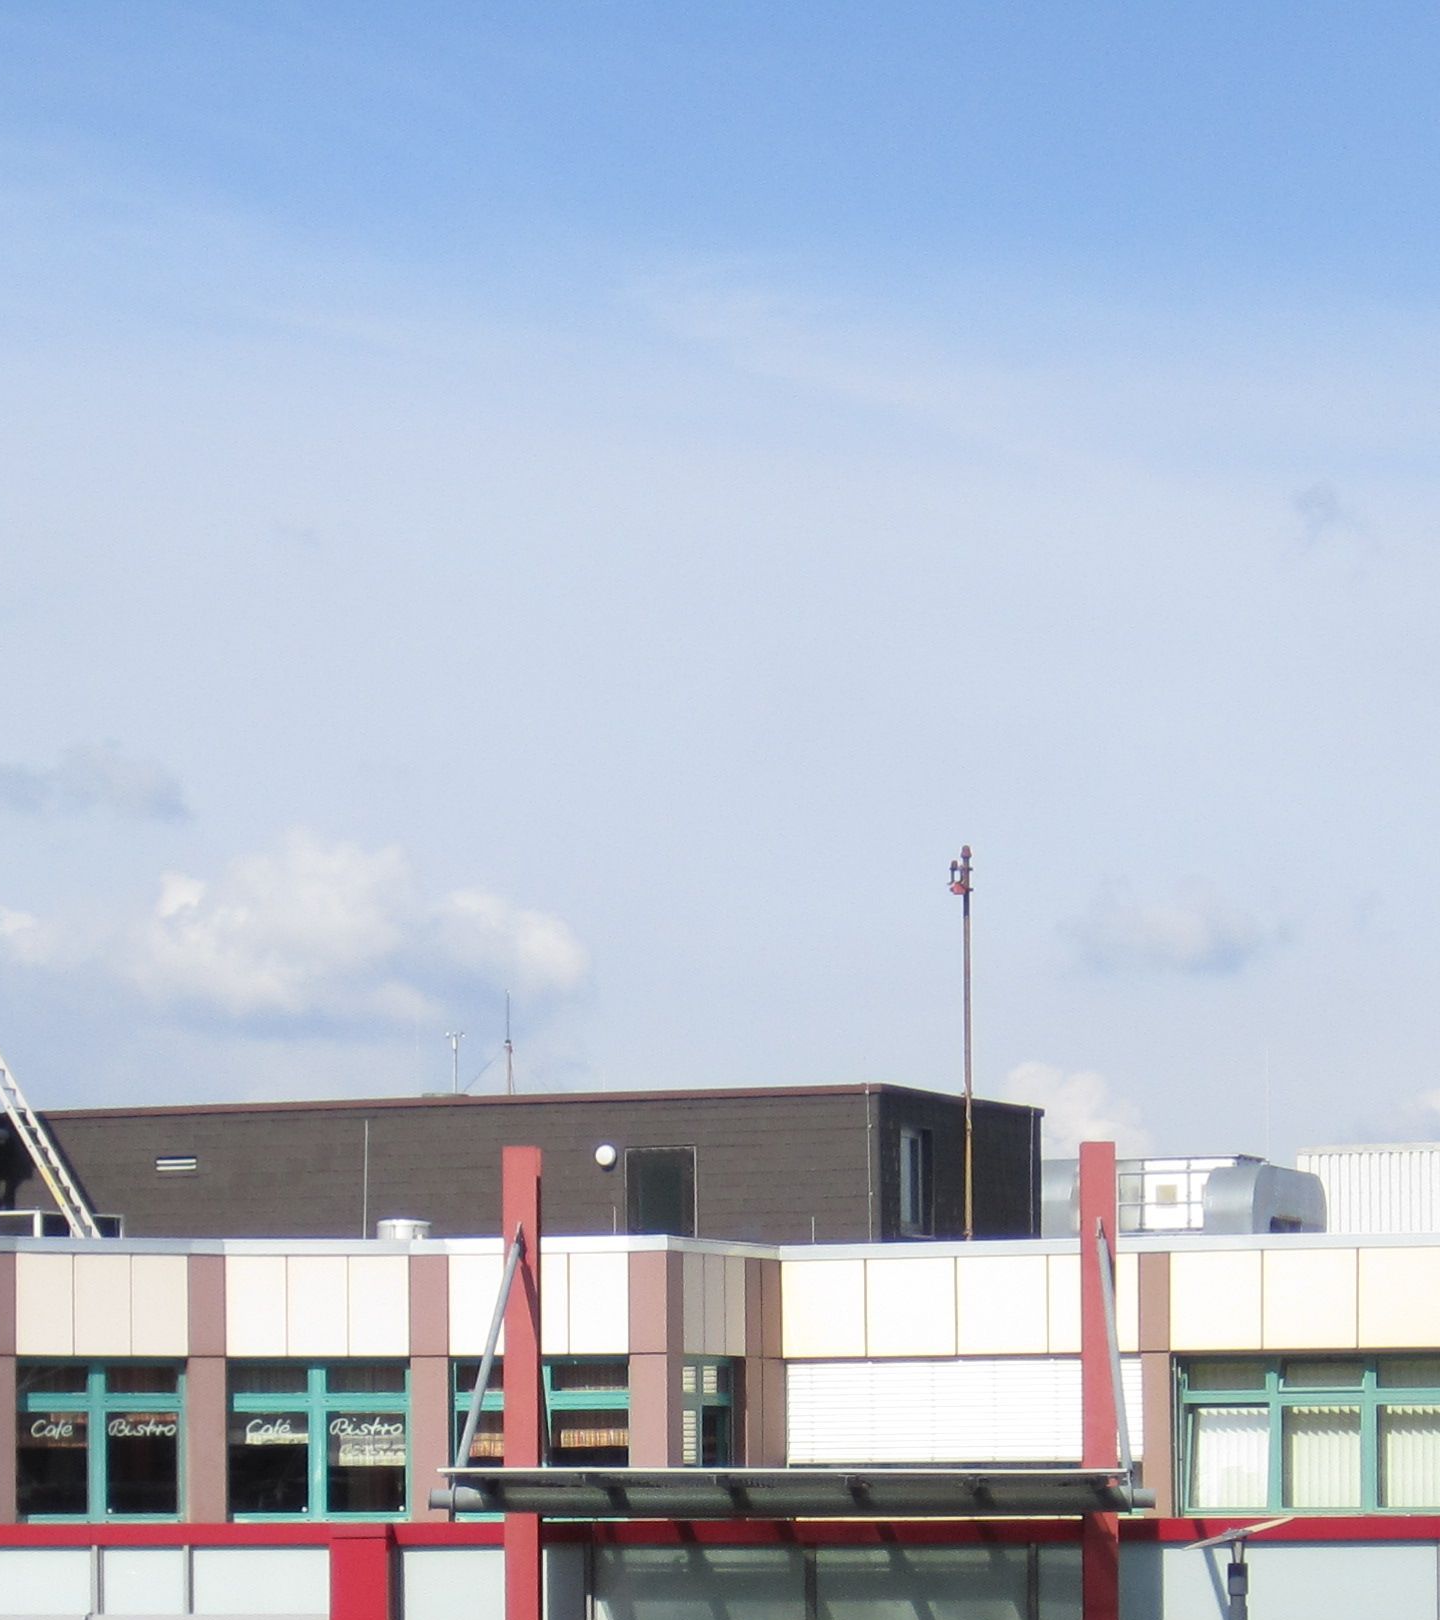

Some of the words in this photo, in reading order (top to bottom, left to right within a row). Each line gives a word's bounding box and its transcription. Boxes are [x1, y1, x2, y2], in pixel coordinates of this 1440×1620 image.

[31, 1418, 73, 1440] Café
[108, 1417, 176, 1437] Bistro
[245, 1418, 292, 1438] Café
[329, 1416, 403, 1436] Bistro
